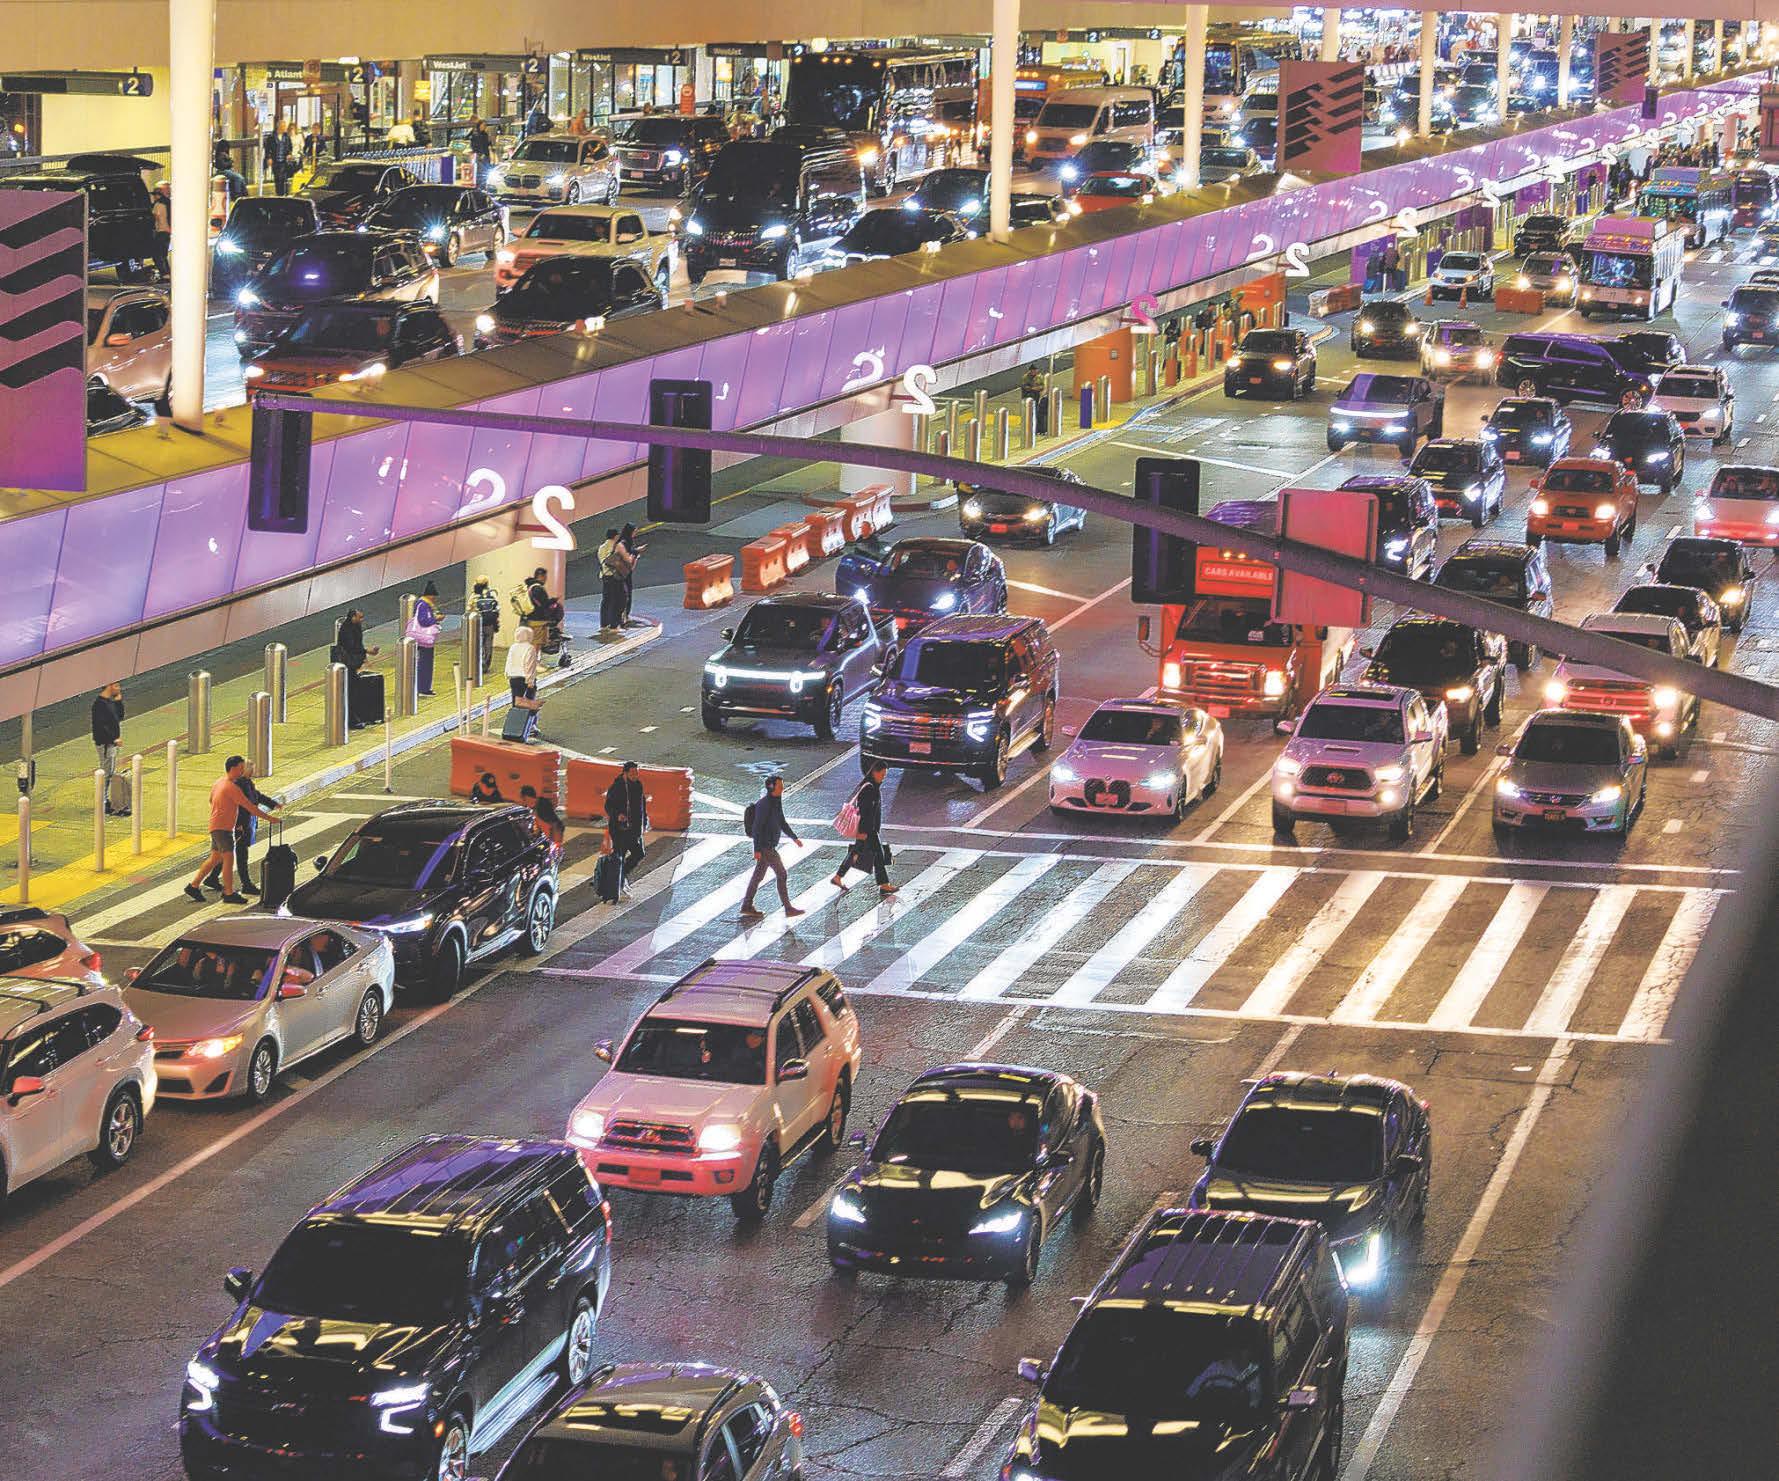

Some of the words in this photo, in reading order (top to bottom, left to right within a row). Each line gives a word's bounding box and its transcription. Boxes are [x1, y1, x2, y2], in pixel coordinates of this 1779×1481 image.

[1089, 32, 1097, 42] 2
[1151, 29, 1159, 39] 2
[671, 50, 681, 64] 2
[433, 60, 467, 70] WestJet
[528, 58, 539, 73] 2
[274, 69, 304, 79] Atlant
[352, 66, 364, 83] 2
[127, 77, 140, 95] 2
[1205, 567, 1227, 577] CARS
